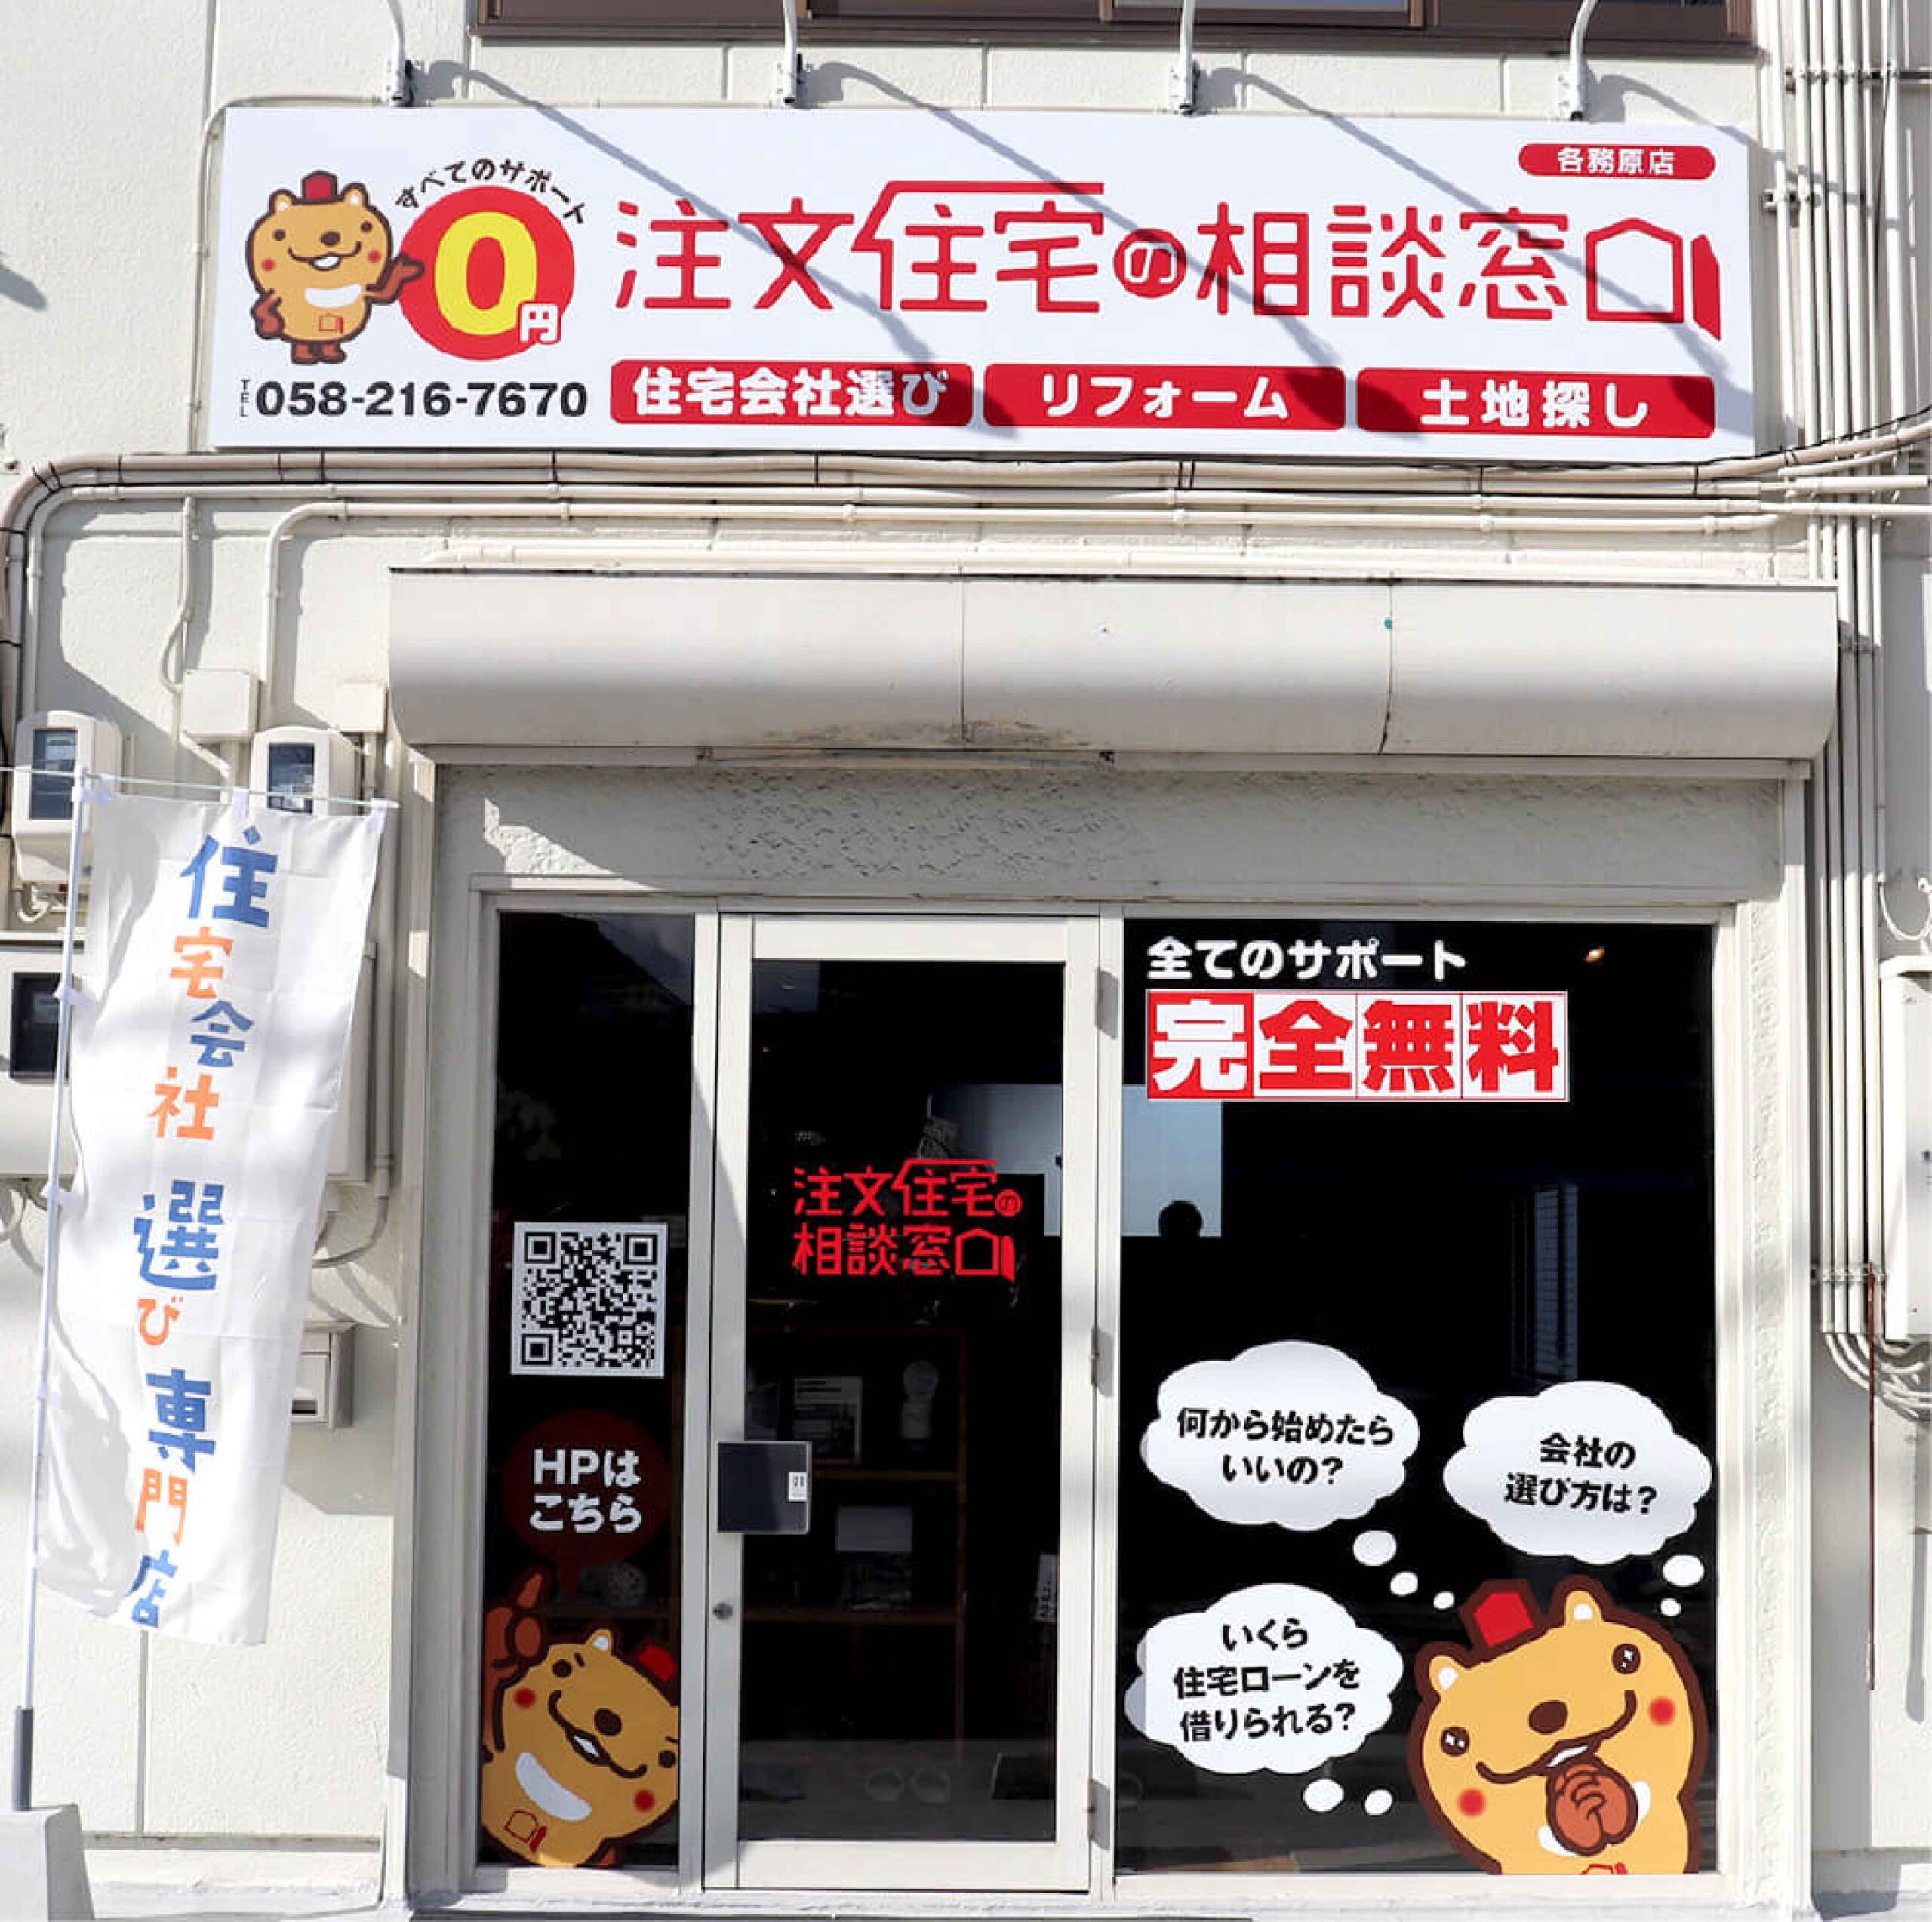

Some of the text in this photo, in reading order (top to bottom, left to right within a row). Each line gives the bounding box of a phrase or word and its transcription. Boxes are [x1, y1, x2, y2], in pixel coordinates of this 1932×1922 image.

[1557, 147, 1675, 176] 各務原店
[395, 158, 585, 224] すべてのサポート
[239, 379, 588, 417] TEL 058-216-7670
[632, 367, 949, 417] 住宅会社選び
[1041, 372, 1289, 420] リフォーム
[1420, 378, 1649, 429] 土地探し
[1146, 936, 1466, 981] 全てのサポート
[1152, 998, 1559, 1093] 完全無料
[793, 1158, 1023, 1217] 注文住宅の
[1176, 1407, 1395, 1446] 何から始めたら
[533, 1449, 641, 1487] HPは
[1222, 1453, 1344, 1485] いいの?
[1539, 1432, 1637, 1470] 会社の
[530, 1493, 642, 1533] こちら
[1504, 1471, 1658, 1515] 選び方は?
[1222, 1618, 1309, 1651] いくら
[1174, 1657, 1361, 1700] 住宅ローンを
[1180, 1702, 1358, 1743] 借りられる?
